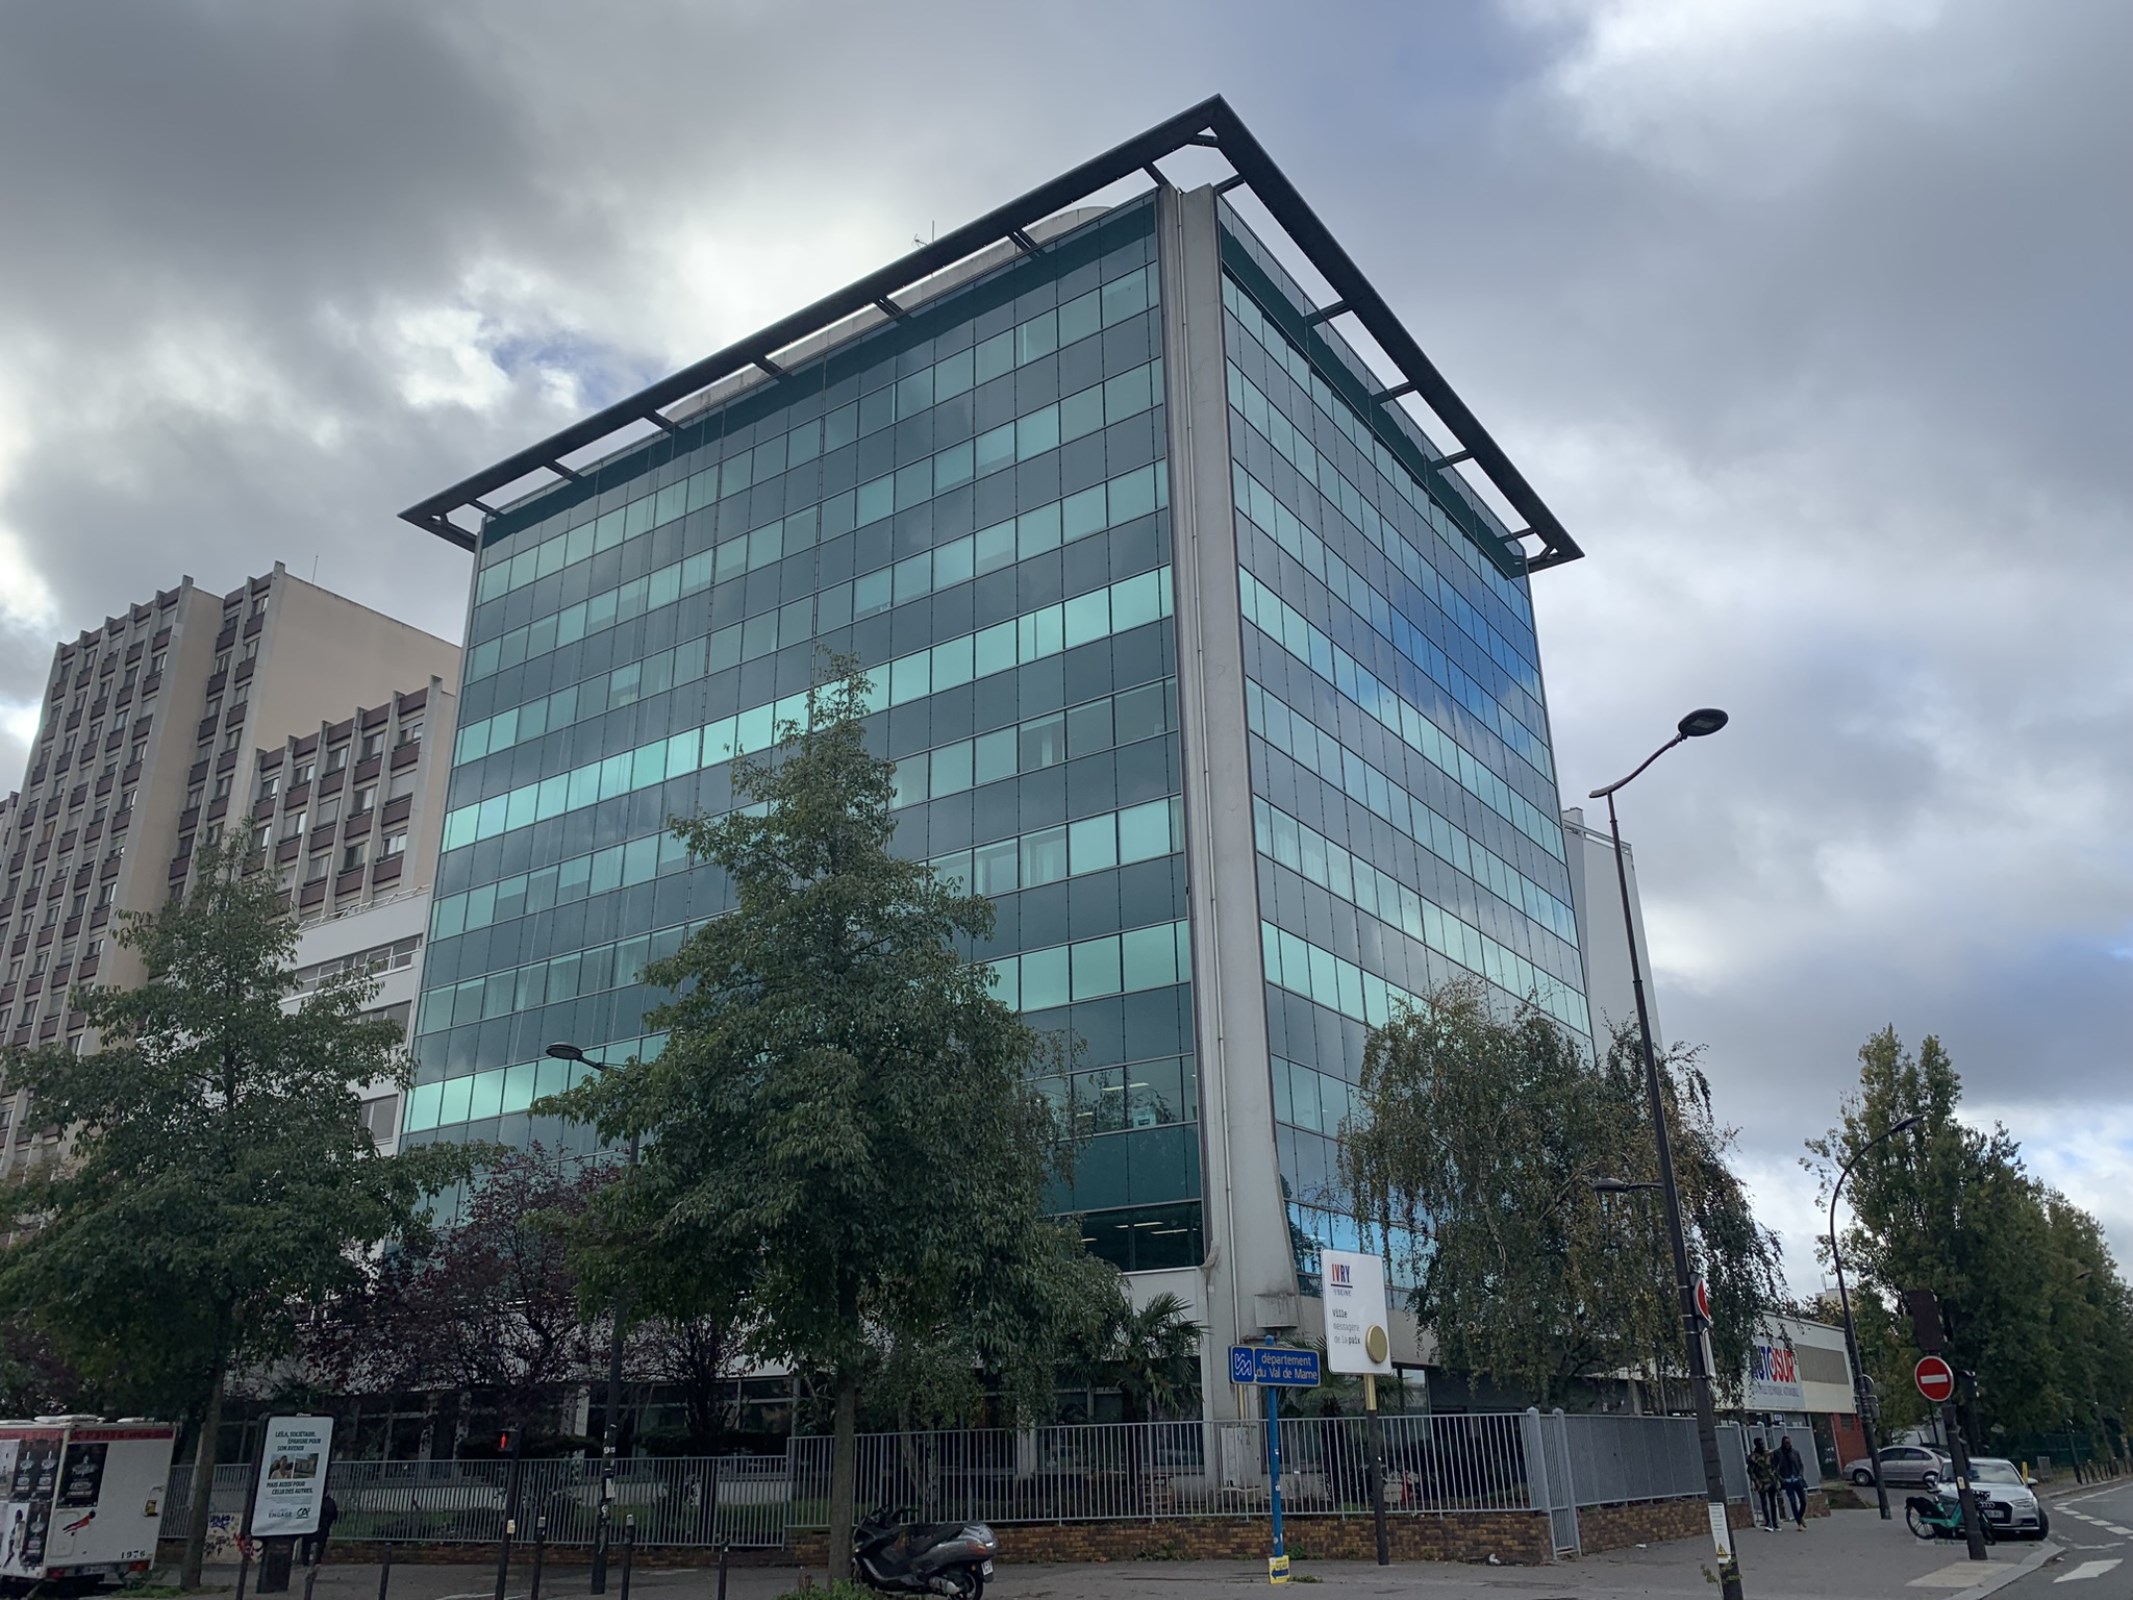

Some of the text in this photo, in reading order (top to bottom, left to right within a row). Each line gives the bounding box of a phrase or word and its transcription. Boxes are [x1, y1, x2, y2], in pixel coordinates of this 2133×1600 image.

[1331, 1263, 1351, 1283] IVRY
[1348, 1336, 1361, 1345] paix
[1261, 1352, 1312, 1366] département
[1256, 1366, 1318, 1380] du Val de Marne
